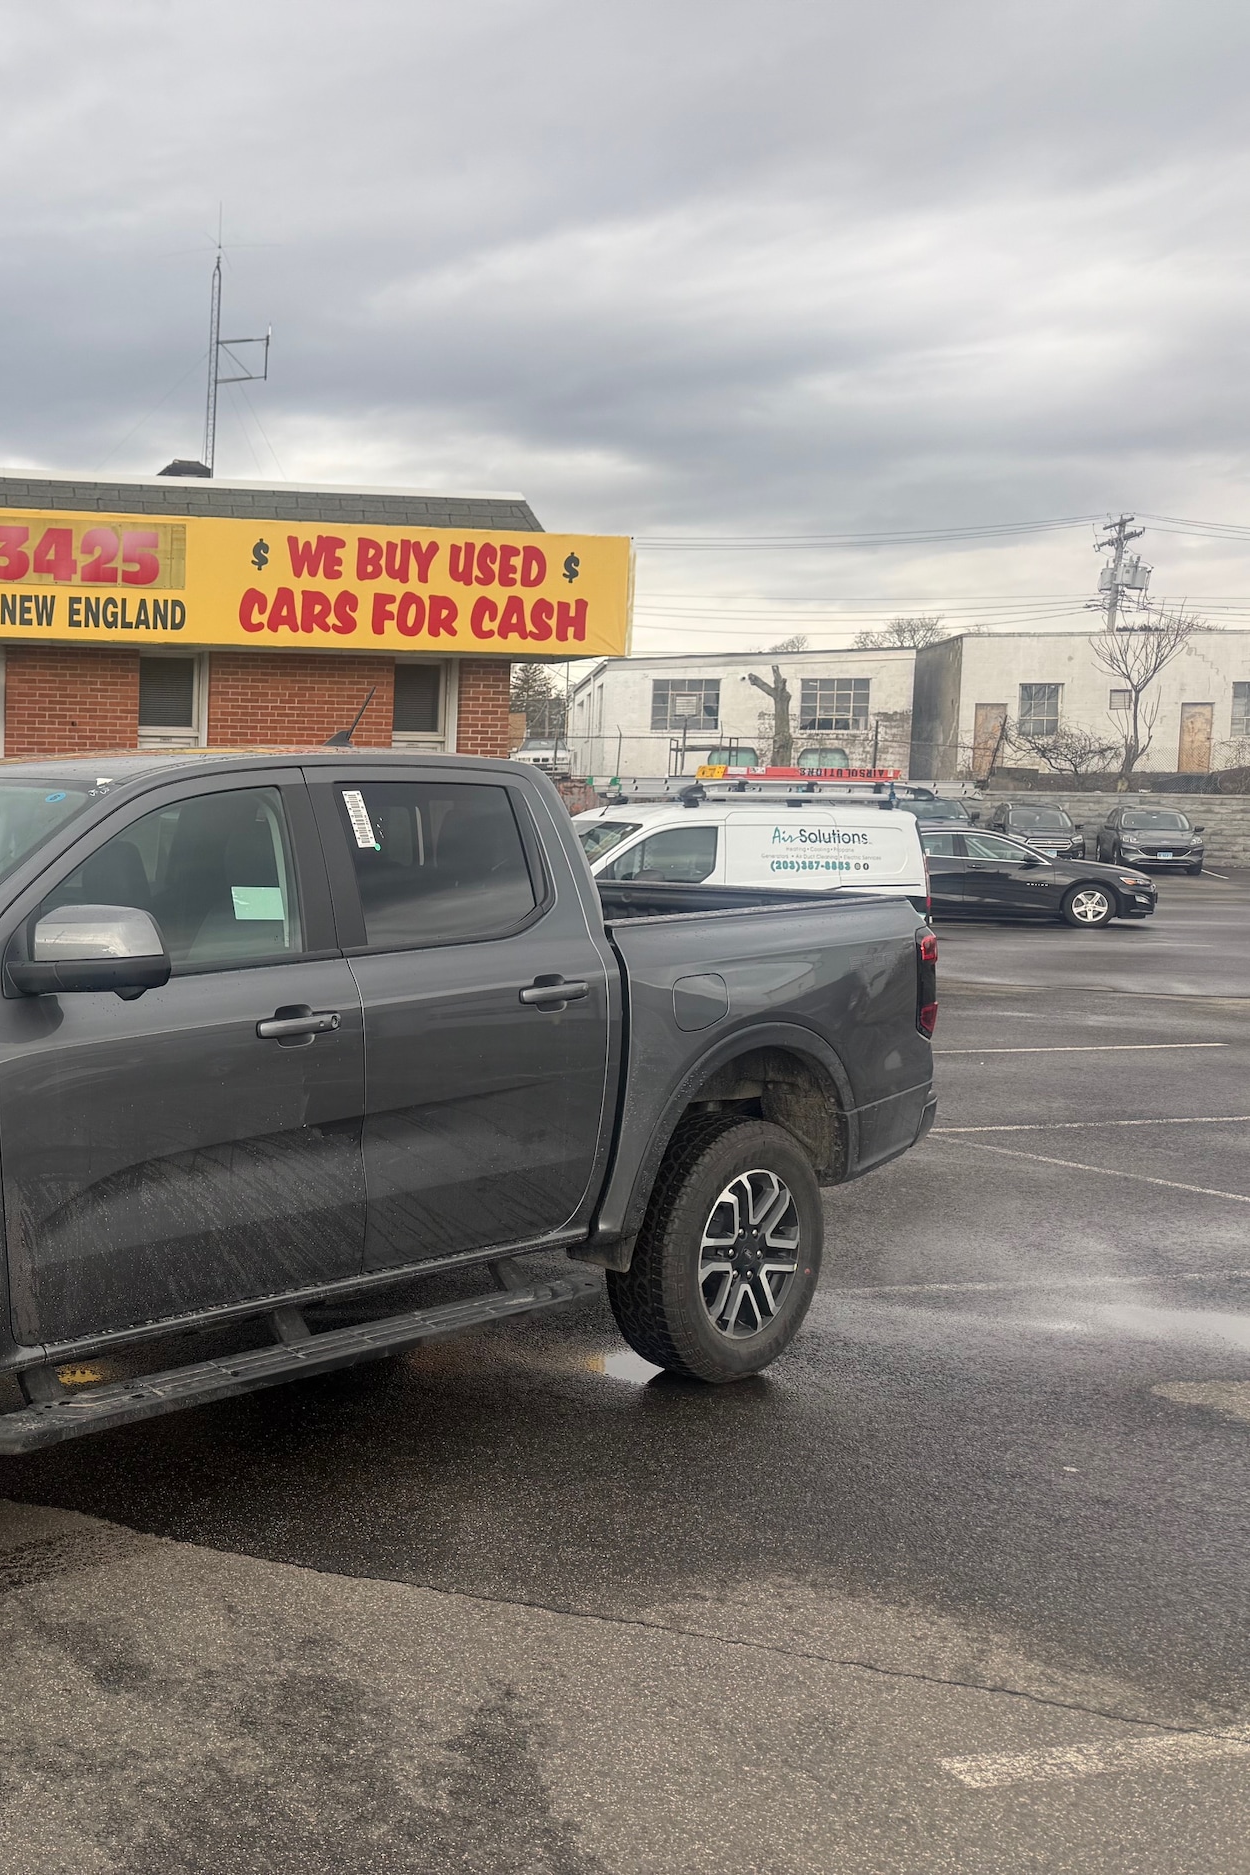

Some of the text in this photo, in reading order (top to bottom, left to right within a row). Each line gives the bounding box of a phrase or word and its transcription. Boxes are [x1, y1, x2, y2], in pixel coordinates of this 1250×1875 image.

[251, 535, 580, 588] $ WE BUY USED $
[0, 593, 56, 627] NEW
[68, 596, 186, 631] ENGLAND
[238, 587, 588, 642] CARS FOR CASH
